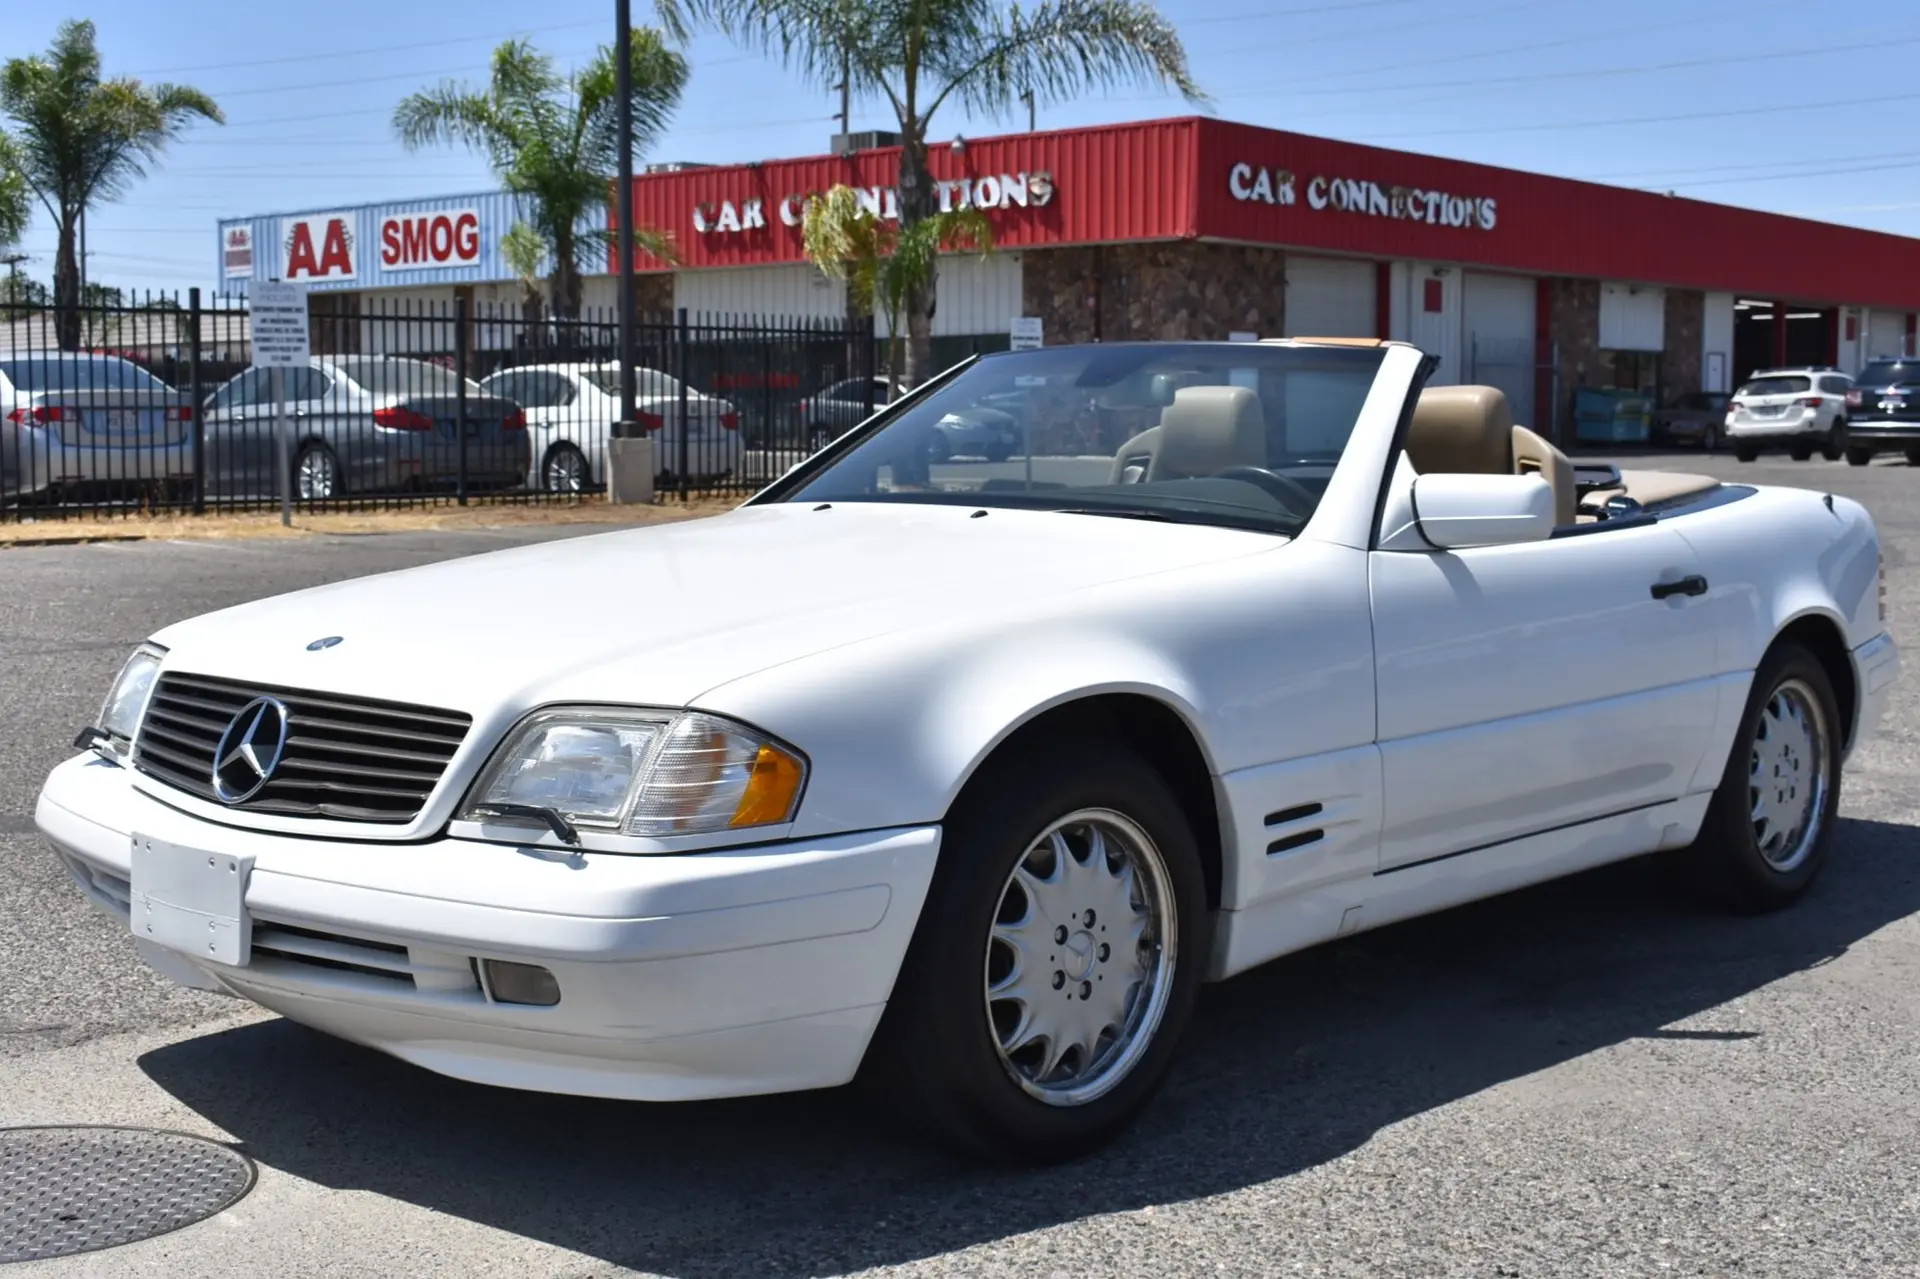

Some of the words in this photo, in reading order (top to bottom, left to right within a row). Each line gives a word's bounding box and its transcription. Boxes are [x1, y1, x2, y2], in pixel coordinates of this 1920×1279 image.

[692, 196, 766, 232] CAR
[779, 172, 1053, 227] CNTIONS
[1229, 162, 1296, 205] CAR
[1307, 176, 1497, 230] CONNECTIONS
[286, 218, 353, 279] AA
[381, 213, 479, 265] SMOG
